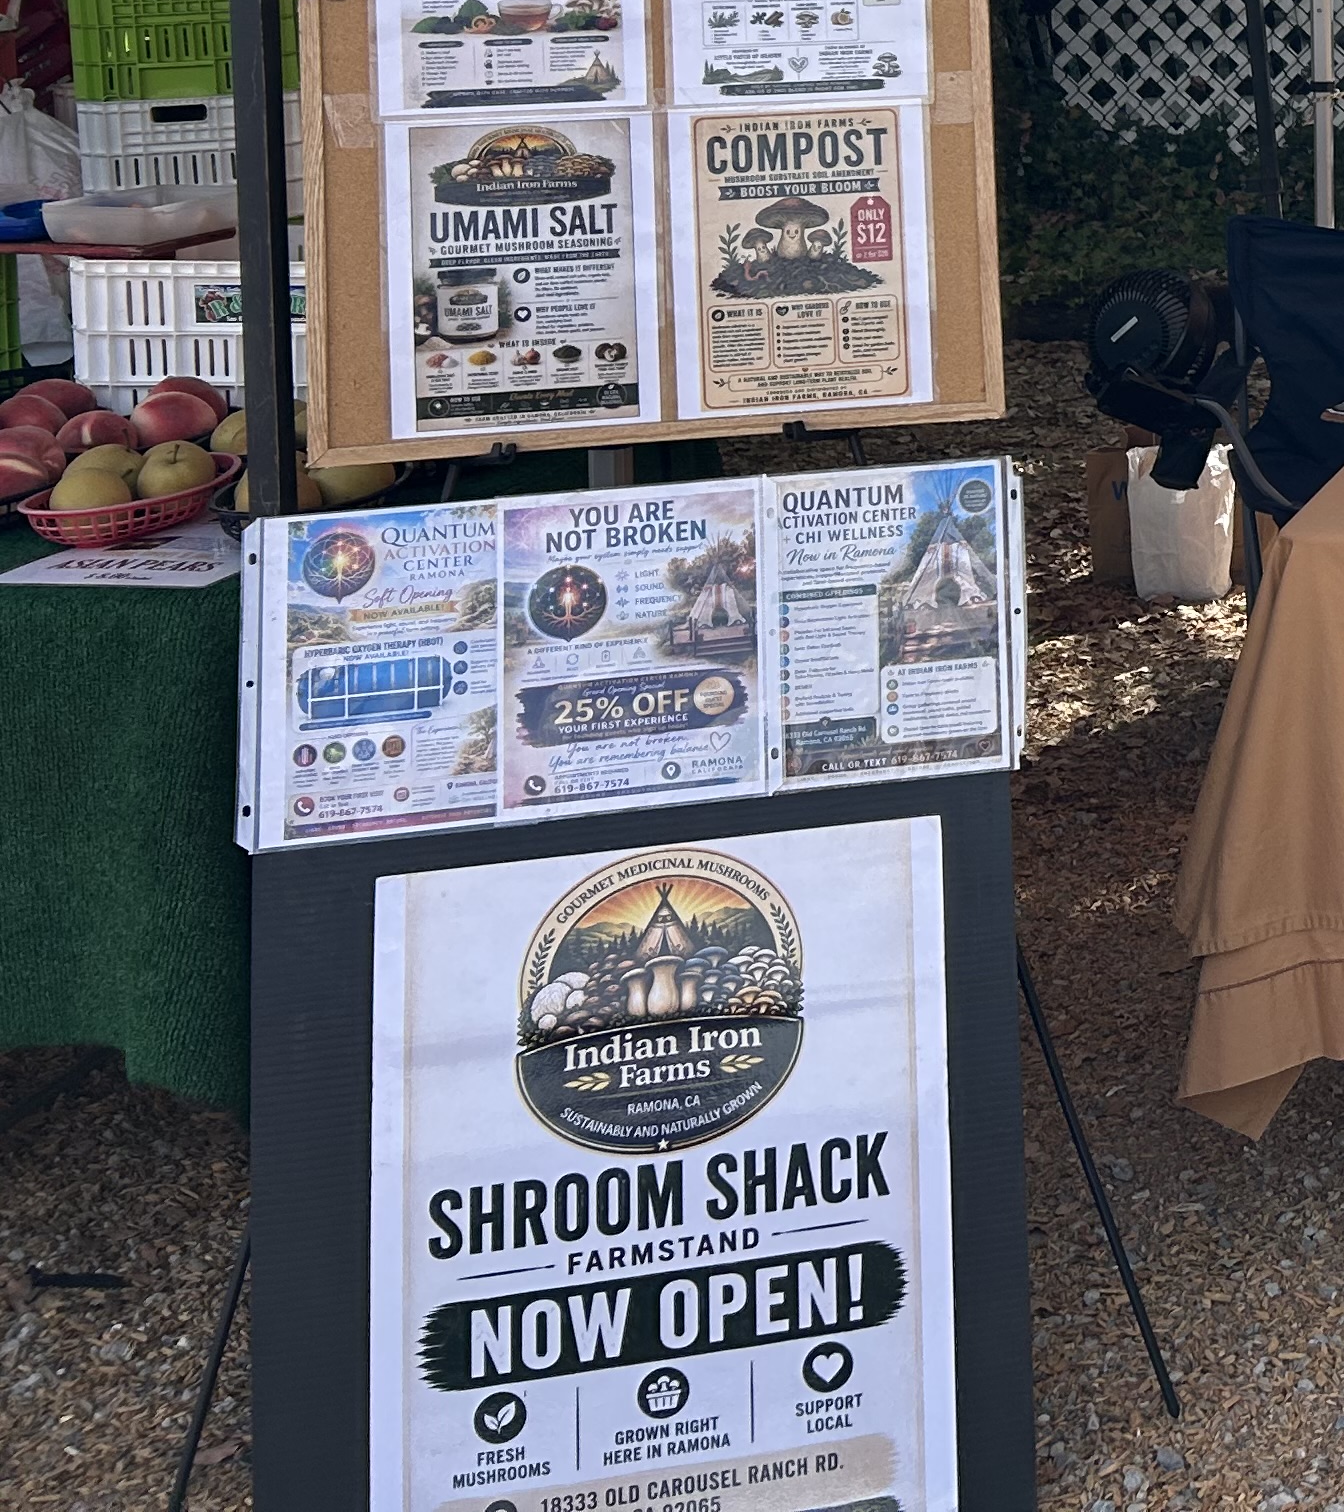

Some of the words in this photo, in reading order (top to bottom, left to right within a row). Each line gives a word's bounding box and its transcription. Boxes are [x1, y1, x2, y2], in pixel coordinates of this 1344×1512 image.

[706, 128, 888, 175] COMPOST
[740, 186, 779, 198] BOOST
[784, 184, 816, 195] YOUR
[821, 182, 861, 193] BLOOM
[430, 207, 538, 243] UMAMI
[550, 203, 617, 237] SALT
[857, 209, 885, 221] ONLY
[857, 223, 886, 244] $12
[440, 243, 490, 255] GOURMET
[495, 240, 553, 252] MUSHROOM
[557, 237, 613, 249] SEASONING
[782, 484, 904, 515] QUANTUM
[569, 506, 619, 528] YOU
[629, 500, 674, 524] ARE
[863, 507, 916, 523] CENTER
[381, 520, 496, 547] QUANTUM
[546, 528, 596, 553] NOT
[606, 519, 707, 548] BROKEN
[796, 532, 822, 545] CHI
[827, 525, 904, 542] WELLNESS
[384, 539, 496, 561] ACTIVATION
[786, 548, 820, 566] Now
[824, 551, 837, 560] in
[840, 544, 896, 562] Ramona
[48, 559, 138, 569] ASIAN
[129, 560, 224, 571] PEARS
[404, 555, 473, 572] CENTER
[410, 569, 465, 581] RAMONA
[363, 588, 398, 608] Soft
[400, 585, 453, 604] Opening
[363, 610, 387, 620] NOW
[554, 696, 624, 725] 25%
[632, 688, 689, 715] OFF
[558, 724, 590, 734] YOUR
[592, 720, 621, 731] FIRST
[625, 713, 688, 727] EXPERIENCE
[822, 762, 844, 772] CALL
[848, 760, 861, 769] OR
[864, 758, 887, 767] TEXT
[557, 874, 615, 924] GOURMET
[617, 858, 694, 883] MEDICINAL
[697, 859, 770, 902] MUSHROOMS
[563, 1032, 685, 1072] Indian
[689, 1024, 762, 1054] Iron
[620, 1058, 710, 1088] Farms
[560, 1107, 633, 1138] SUSTAINABLY
[634, 1124, 659, 1138] AND
[661, 1108, 721, 1136] NATURALLY
[722, 1081, 763, 1116] GROWN
[627, 1098, 682, 1116] RAMONA,
[685, 1095, 700, 1108] CA
[428, 1160, 684, 1260] SHROOM
[706, 1131, 890, 1221] SHACK
[567, 1227, 760, 1276] FARMSTAND
[470, 1288, 631, 1379] NOW
[659, 1253, 864, 1351] OPEN!
[795, 1393, 863, 1417] SUPPORT
[615, 1425, 671, 1446] GROWN
[675, 1416, 719, 1438] RIGHT
[806, 1414, 852, 1434] LOCAL
[476, 1447, 526, 1466] FRESH
[603, 1446, 642, 1467] HERE
[646, 1445, 661, 1460] IN
[665, 1433, 730, 1458] RAMONA
[453, 1461, 551, 1489] MUSHROOMS
[540, 1491, 598, 1512] 18333
[605, 1485, 640, 1507] OLD
[647, 1469, 742, 1500] CAROUSEL
[748, 1456, 808, 1485] RANCH
[815, 1452, 844, 1473] RD.
